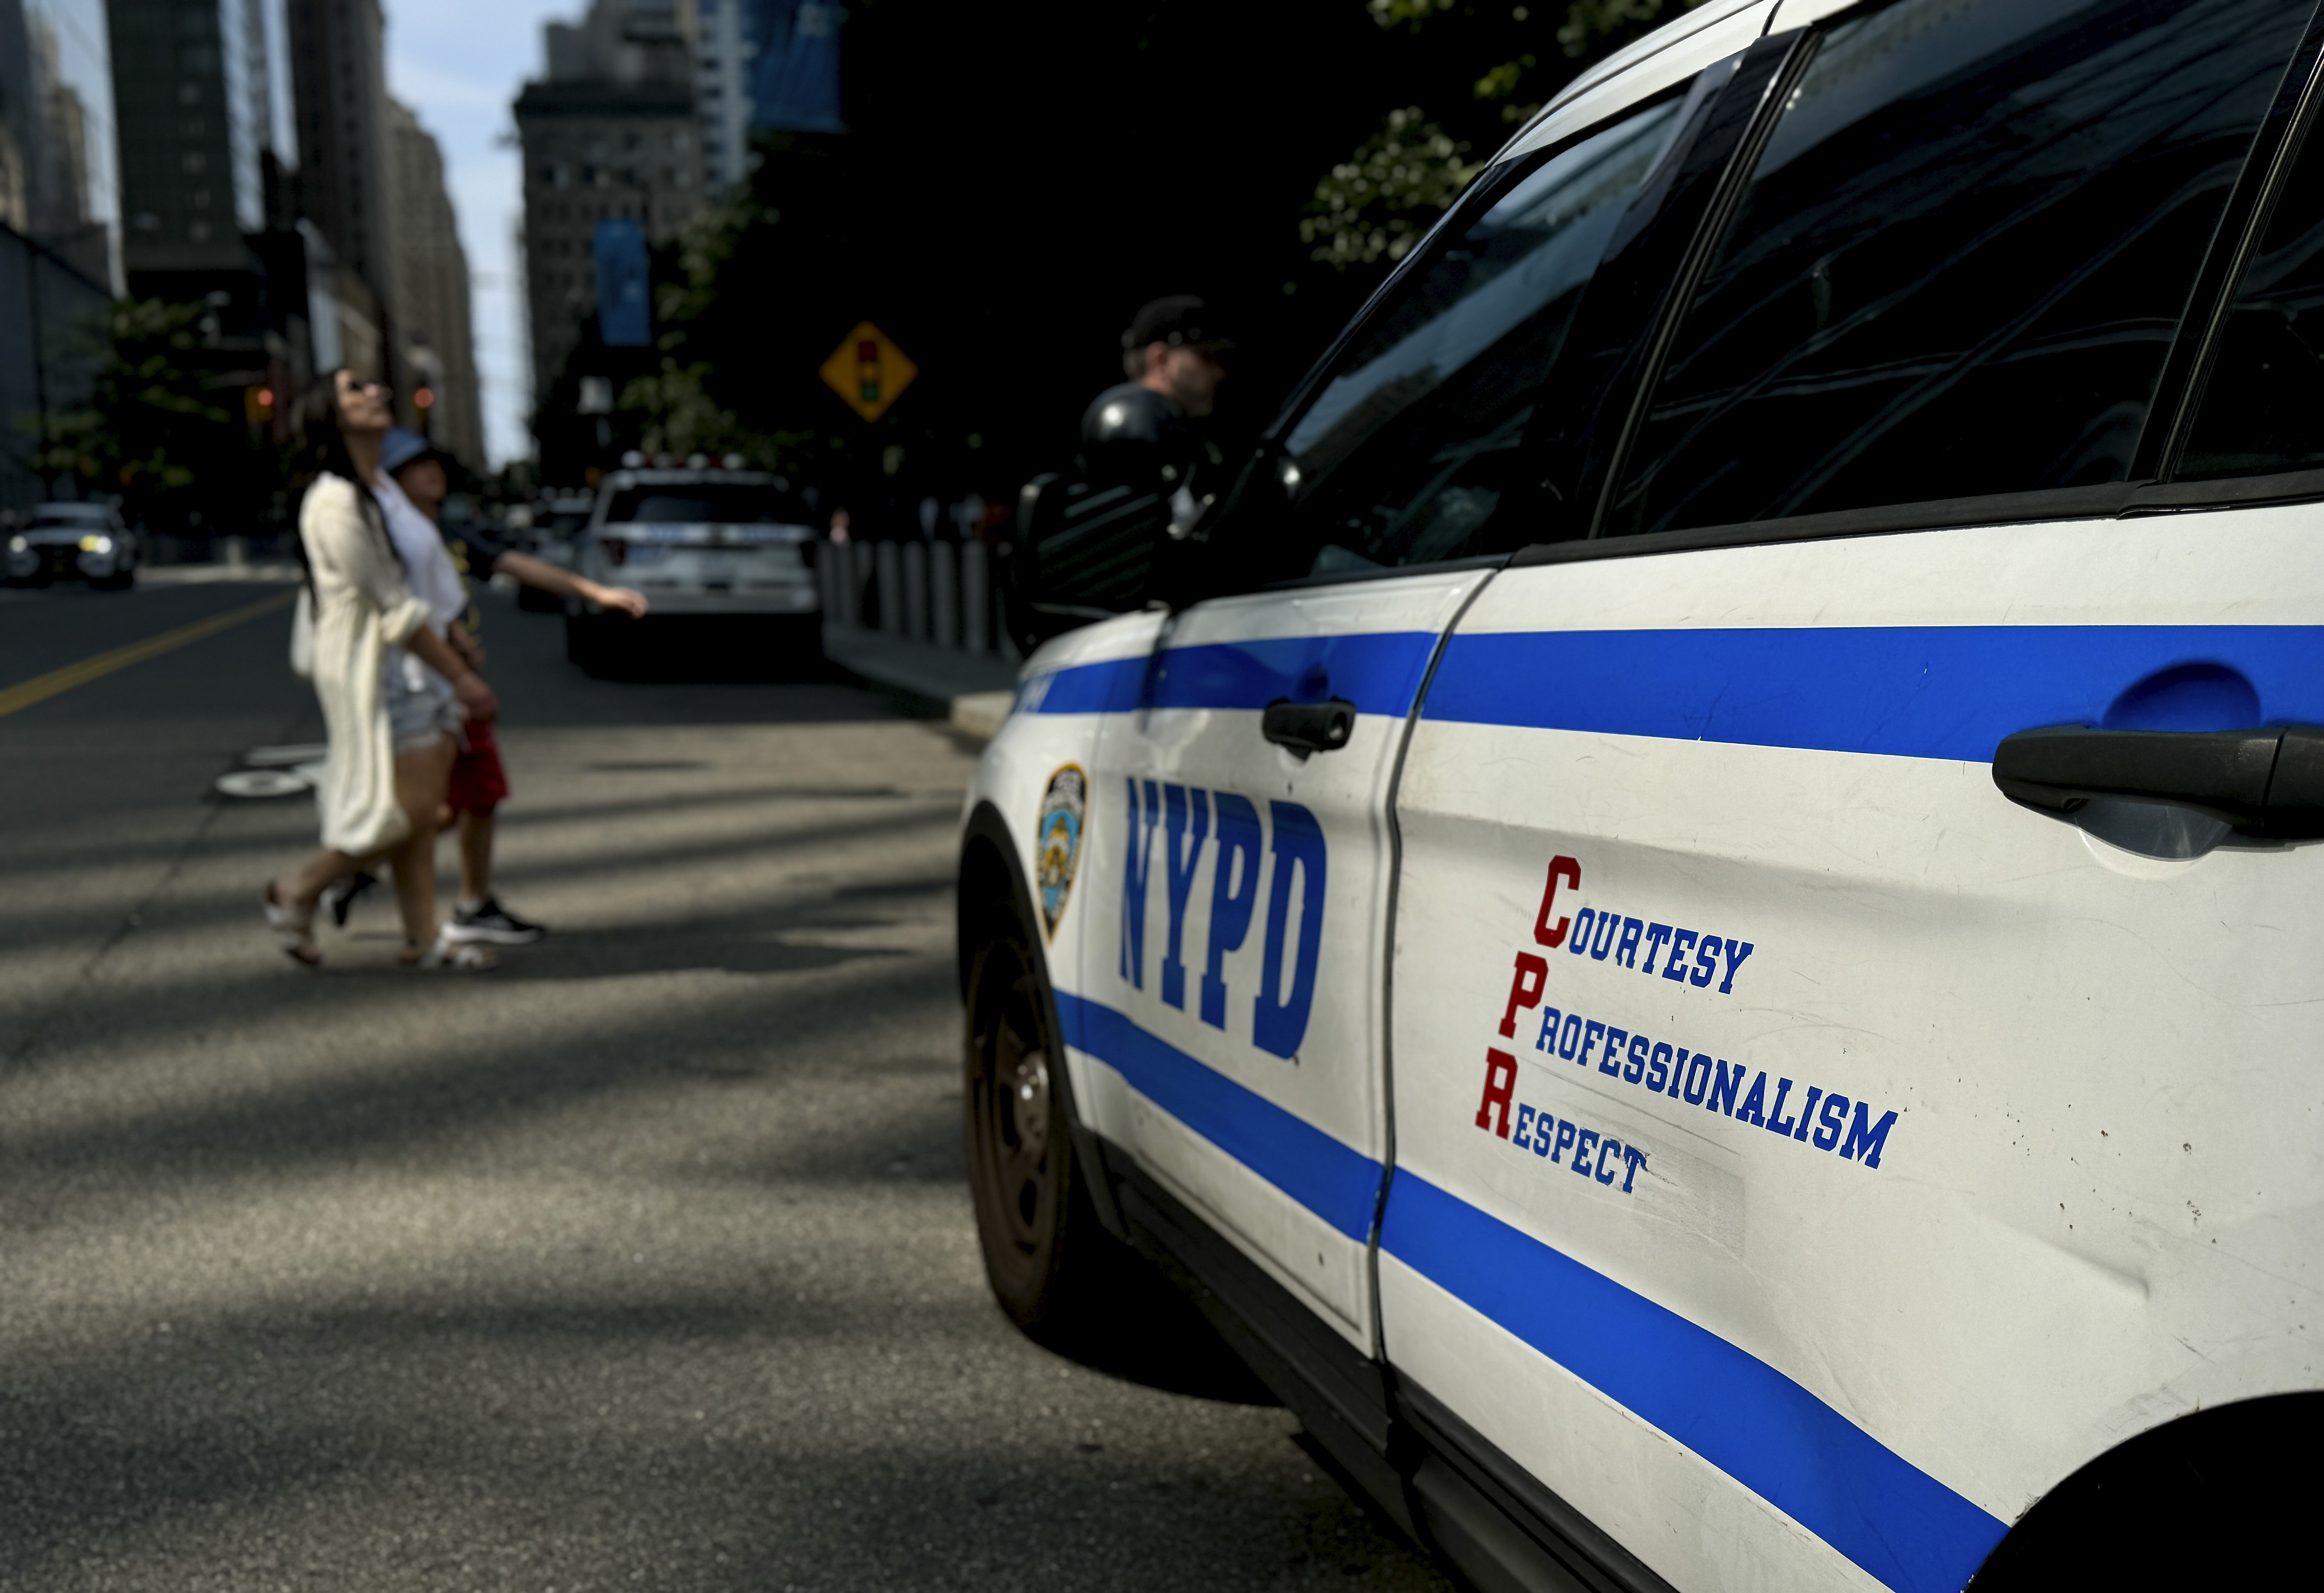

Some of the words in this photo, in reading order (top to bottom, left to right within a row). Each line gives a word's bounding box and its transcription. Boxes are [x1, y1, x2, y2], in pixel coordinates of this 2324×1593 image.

[1119, 776, 1327, 1061] NYPD
[1534, 855, 1754, 995] COURTESY
[1475, 1046, 1648, 1195] RESPECT
[1498, 951, 1898, 1169] PROFESSIONALISM
